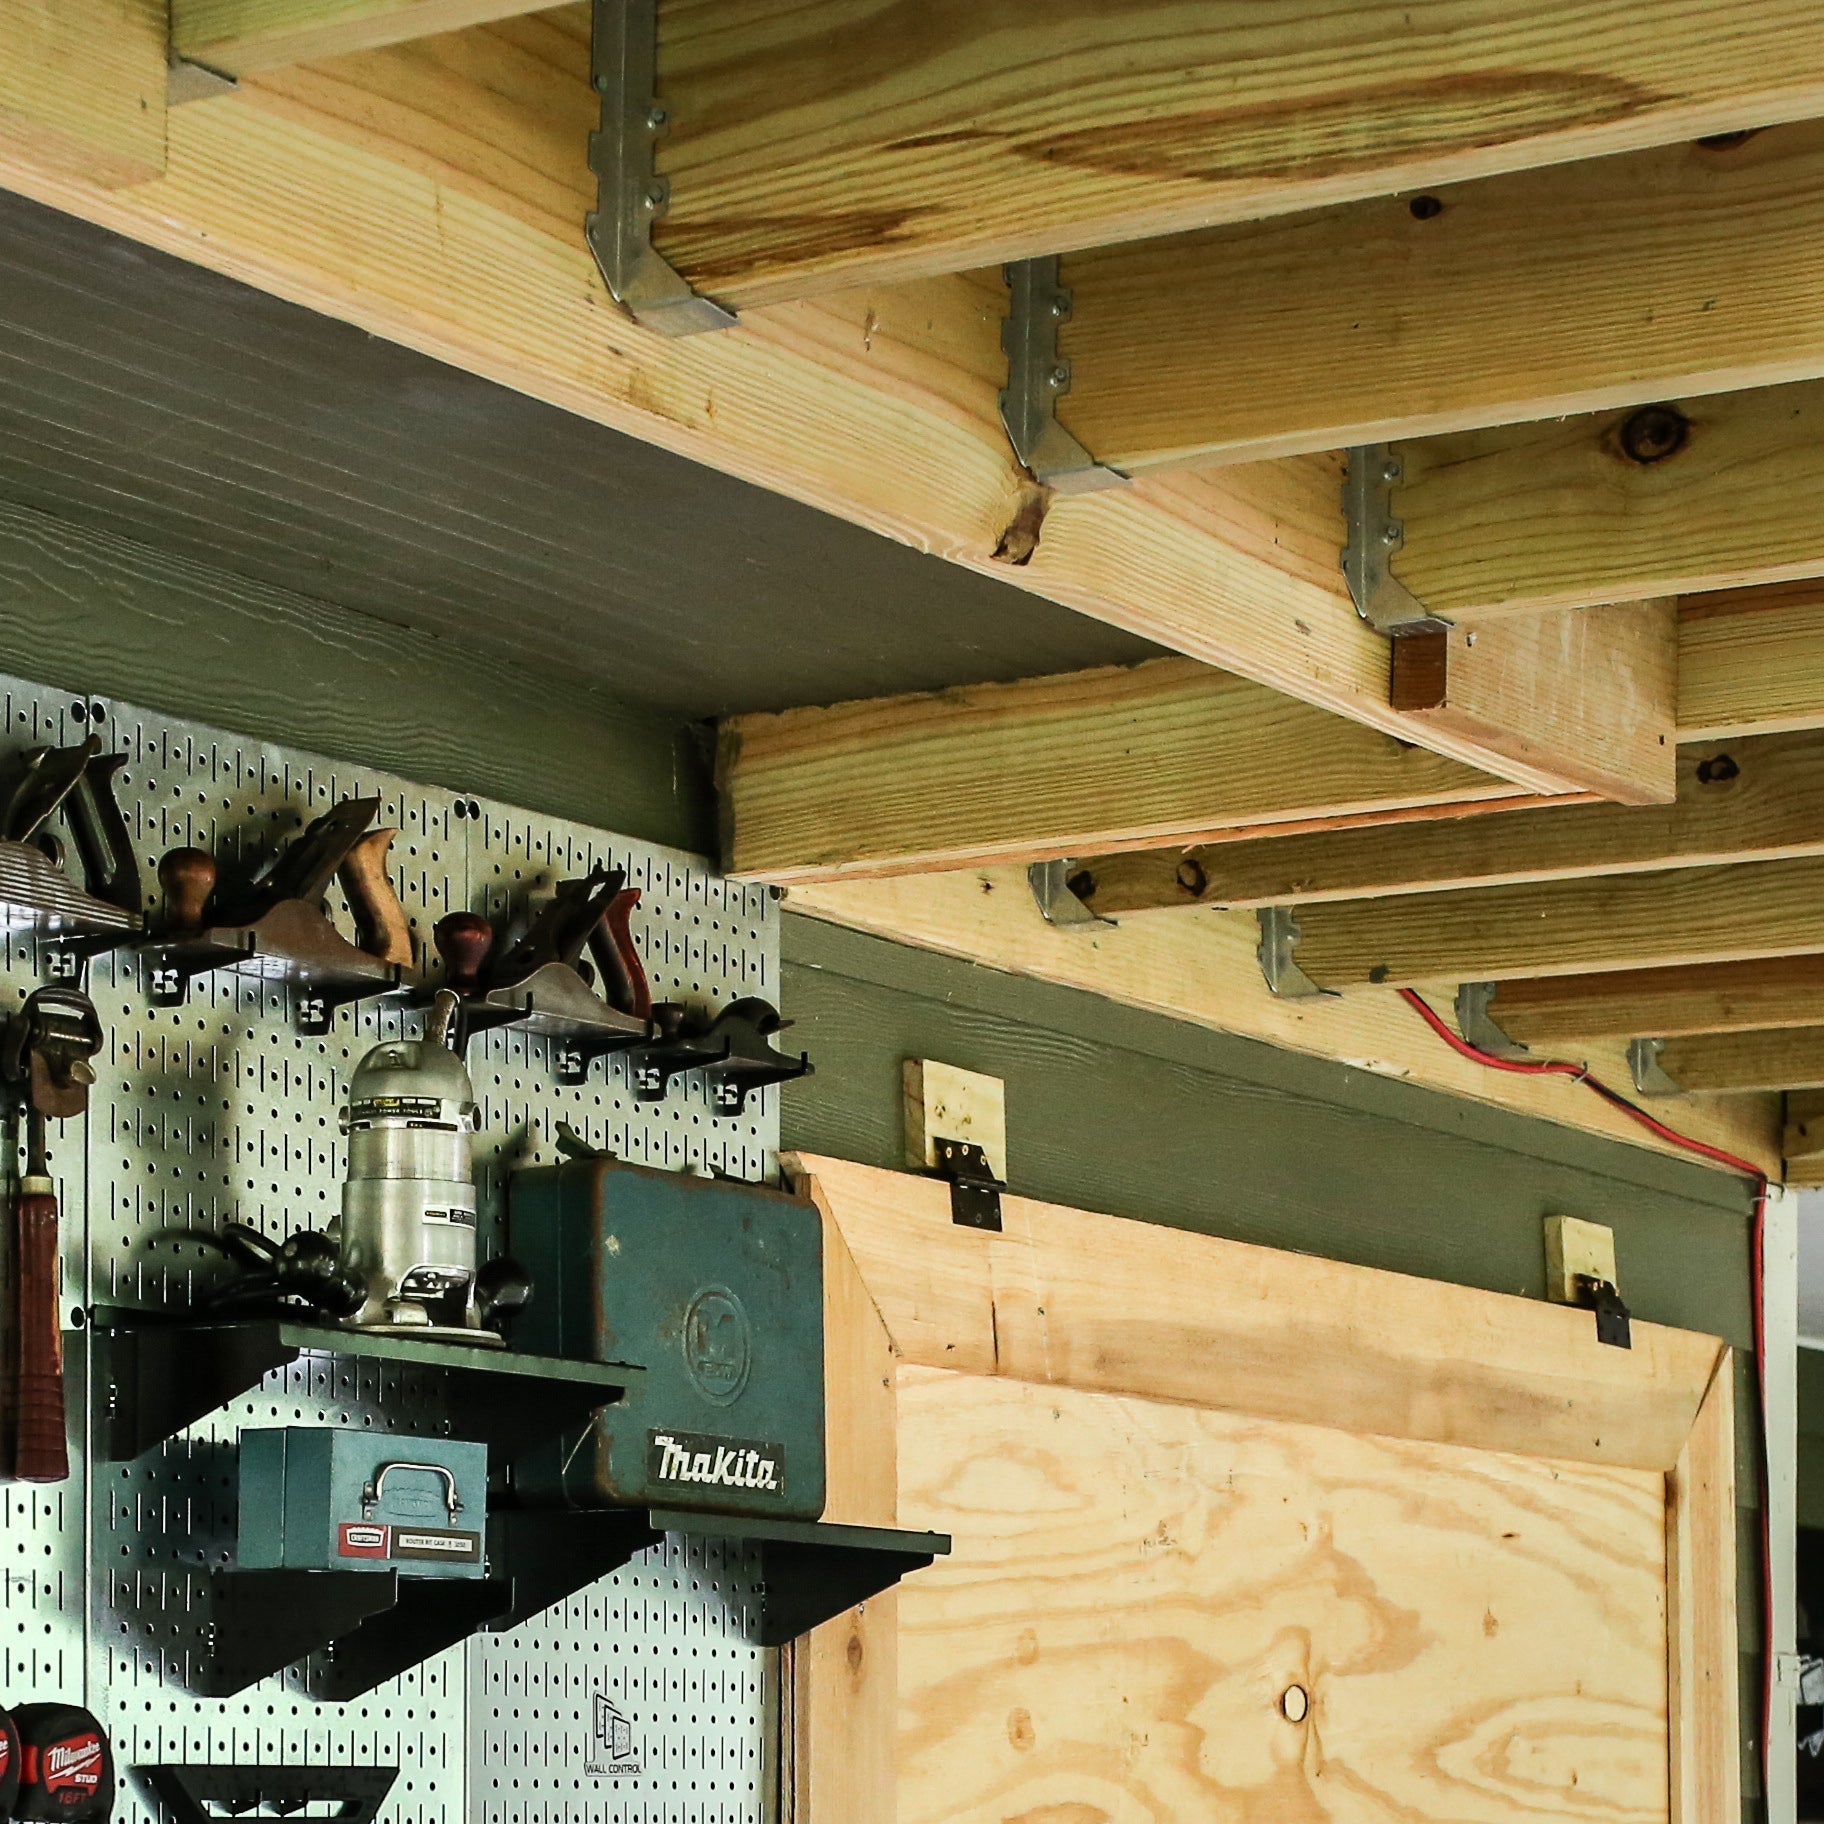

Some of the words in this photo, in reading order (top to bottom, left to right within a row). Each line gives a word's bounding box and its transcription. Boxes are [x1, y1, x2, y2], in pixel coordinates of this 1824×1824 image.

[654, 1435, 778, 1491] Makita
[47, 1742, 101, 1772] Milwaukee
[74, 1773, 98, 1784] STUD
[586, 1764, 607, 1774] WALL
[608, 1763, 642, 1774] CONTROL
